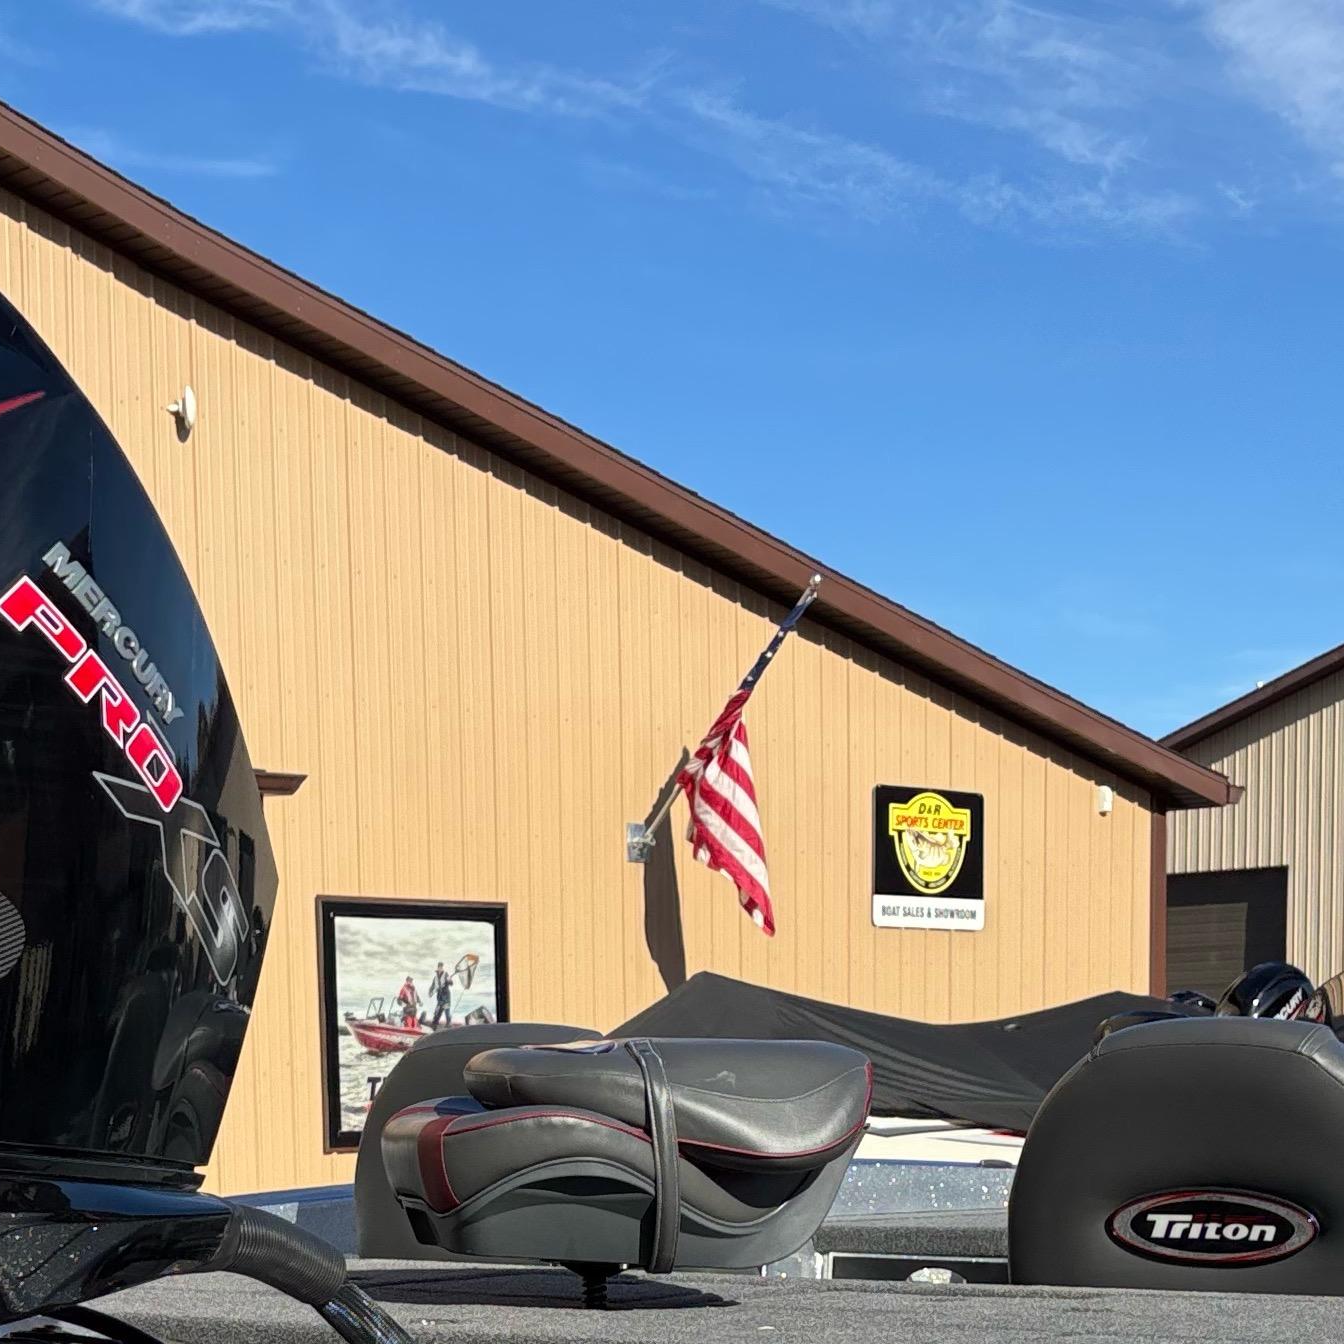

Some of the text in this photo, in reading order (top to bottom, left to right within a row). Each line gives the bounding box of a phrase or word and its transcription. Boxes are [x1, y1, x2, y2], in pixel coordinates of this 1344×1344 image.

[41, 541, 184, 725] MERCURY
[895, 815, 965, 831] SPORTS CENTER
[881, 905, 977, 920] BOAT SALES & SHOWROOM
[1146, 1213, 1277, 1242] Triton
